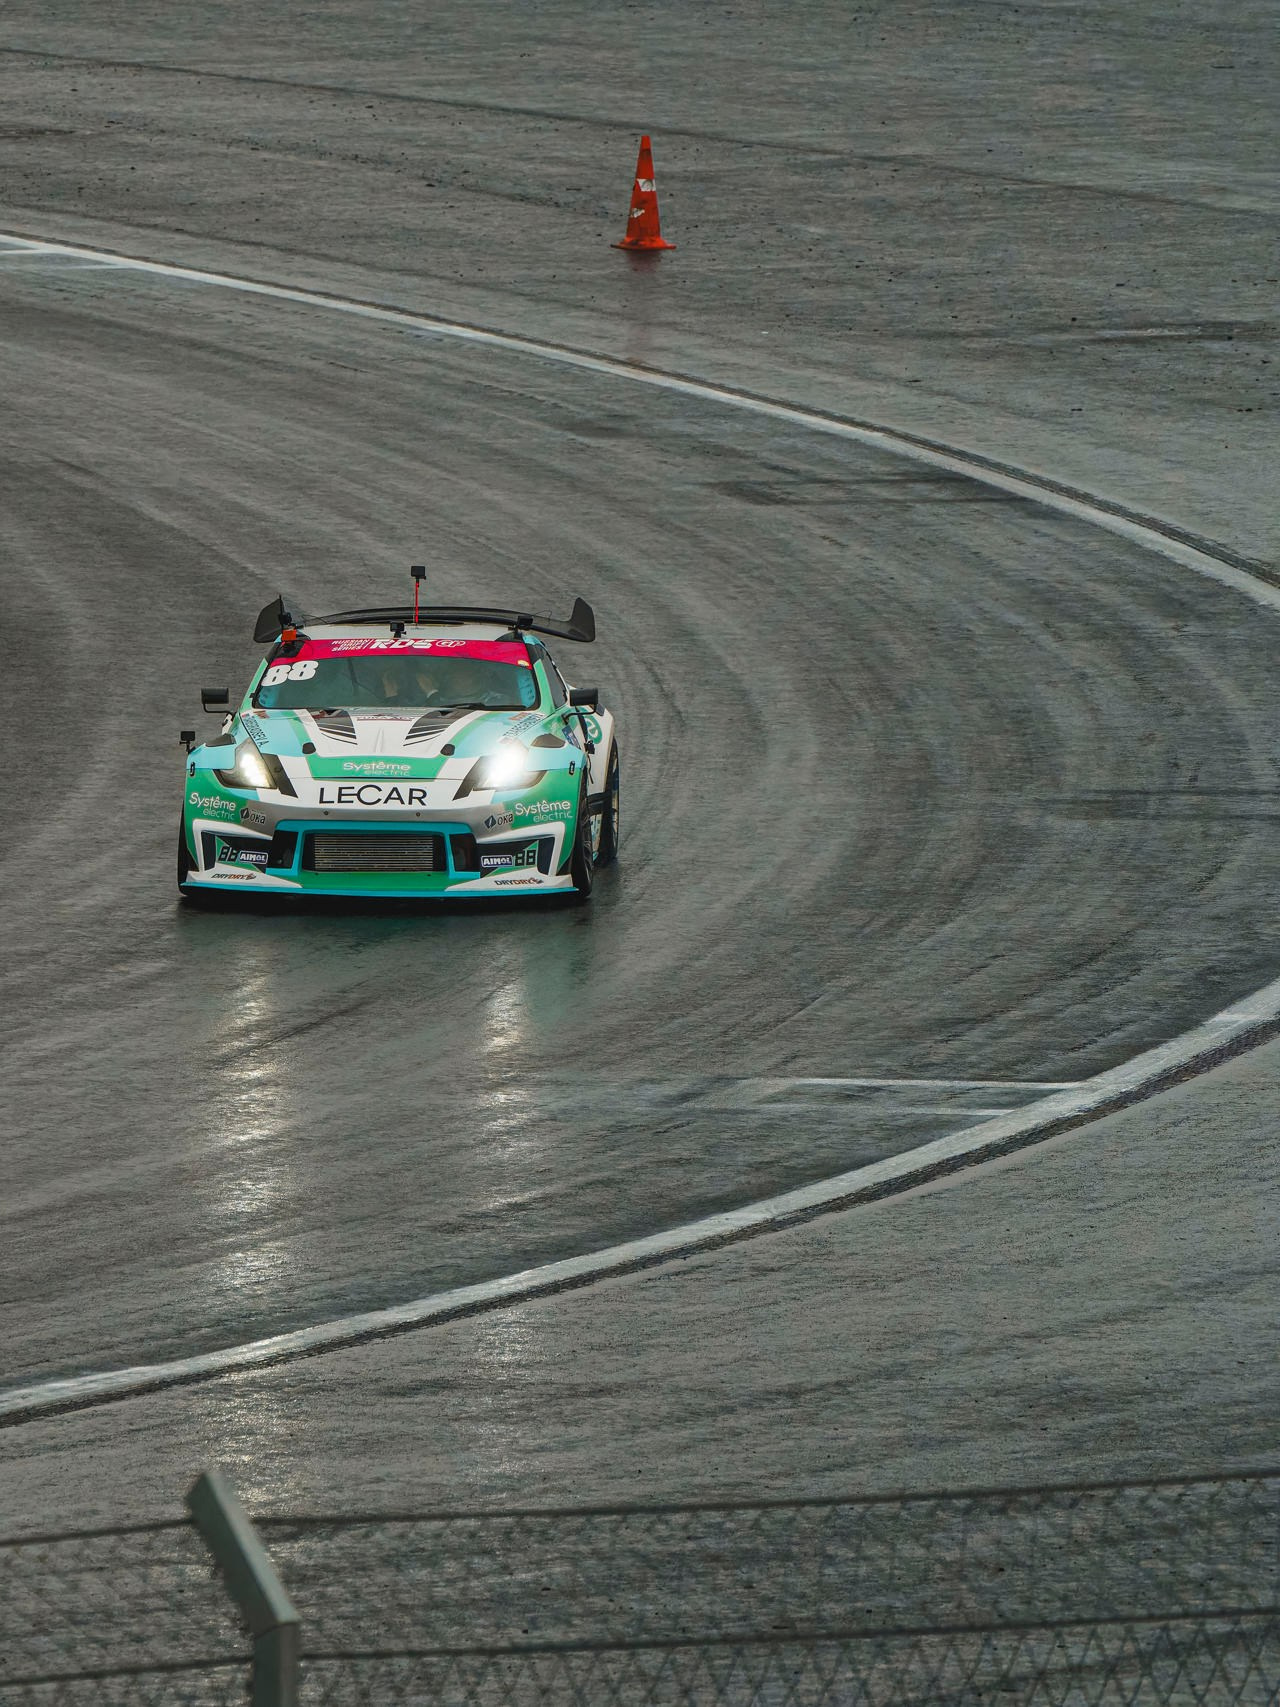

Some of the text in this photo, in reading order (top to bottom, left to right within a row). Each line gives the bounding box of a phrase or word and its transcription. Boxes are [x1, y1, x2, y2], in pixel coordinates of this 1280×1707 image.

[370, 639, 436, 649] RDS
[261, 660, 319, 687] 88
[343, 760, 412, 772] Systême
[364, 769, 411, 777] electric
[189, 792, 237, 811] Systême
[318, 784, 428, 806] LECAR
[202, 808, 236, 821] electric
[515, 800, 571, 817] Systême
[533, 811, 573, 823] electric
